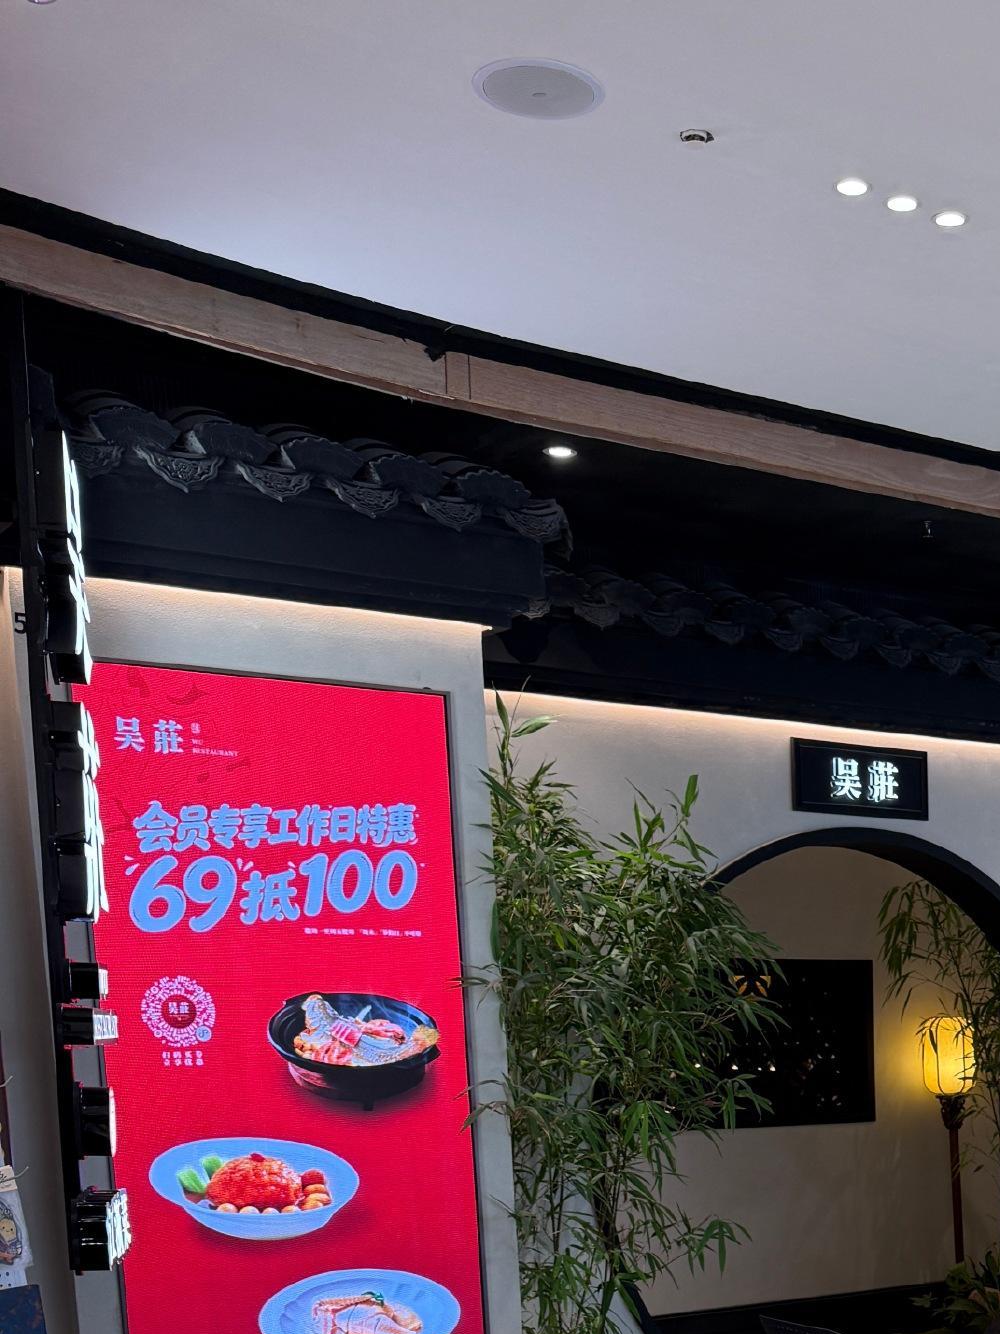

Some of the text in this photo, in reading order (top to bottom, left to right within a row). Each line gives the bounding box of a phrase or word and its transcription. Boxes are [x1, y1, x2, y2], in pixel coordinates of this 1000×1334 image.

[133, 800, 418, 852] 会员专享工作日特惠
[128, 849, 419, 933] 69抵100
